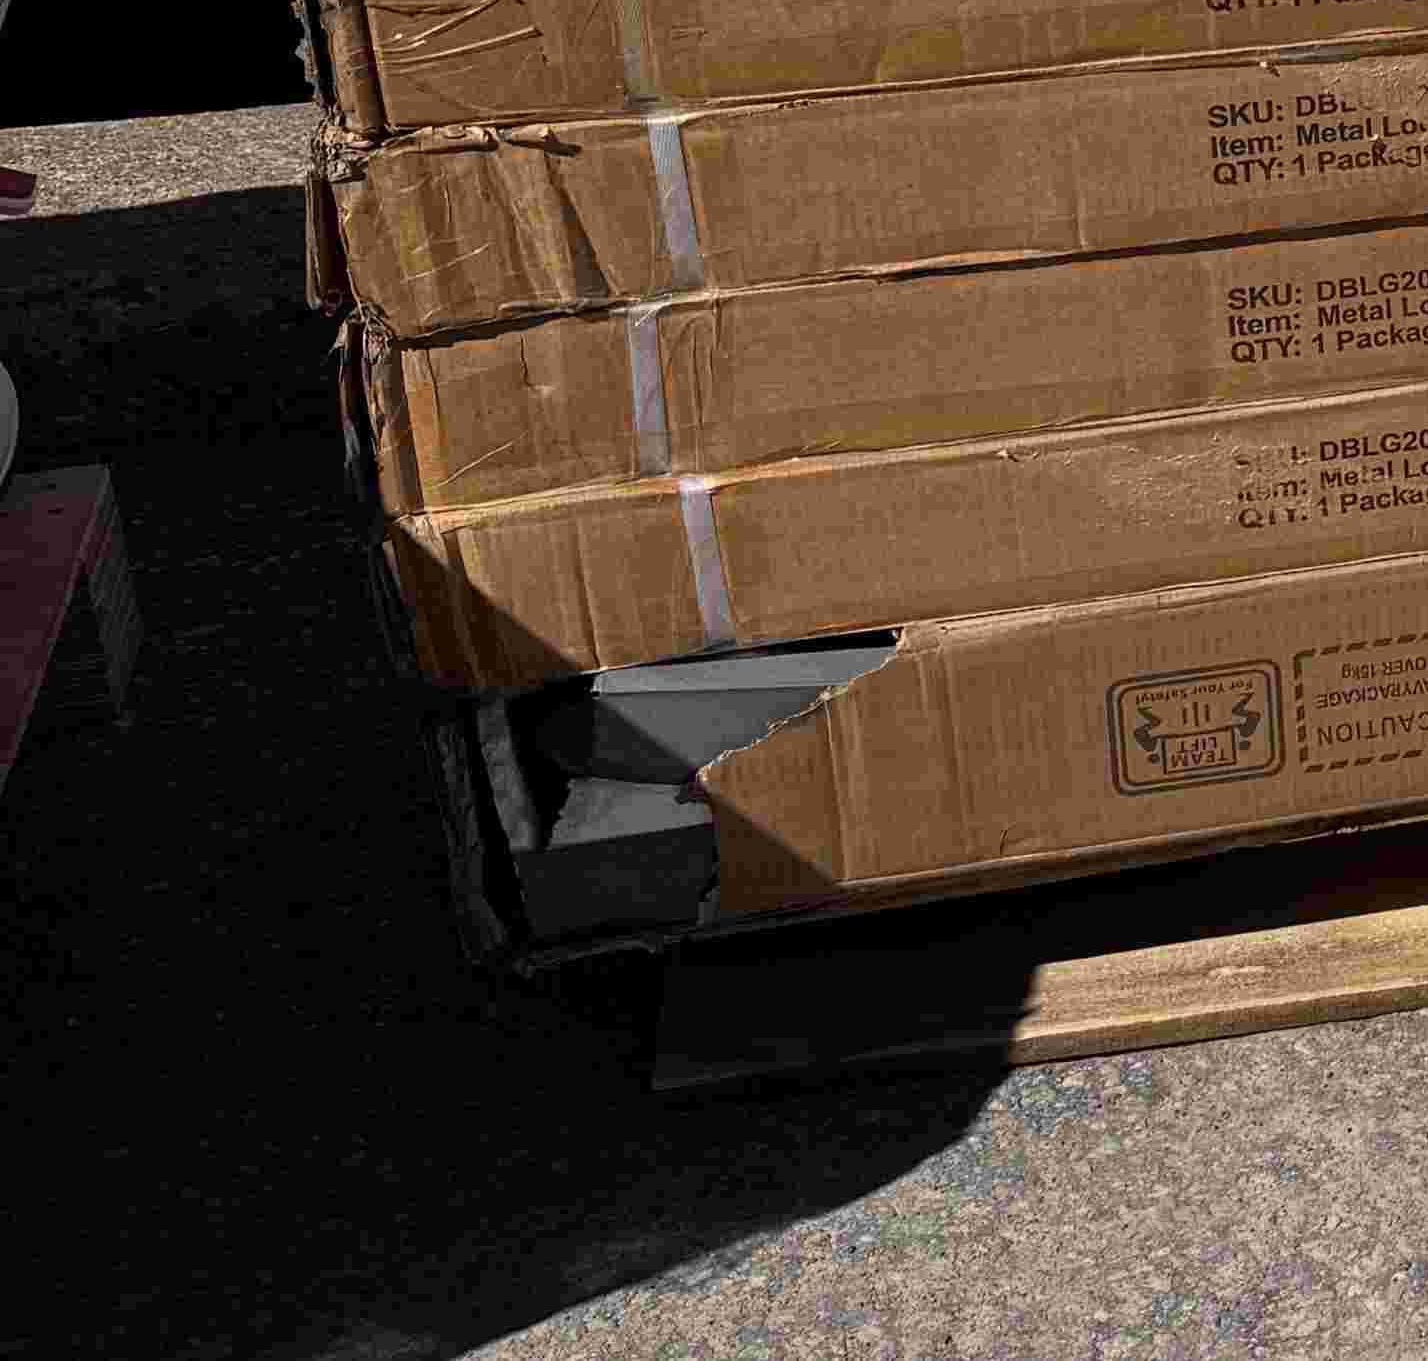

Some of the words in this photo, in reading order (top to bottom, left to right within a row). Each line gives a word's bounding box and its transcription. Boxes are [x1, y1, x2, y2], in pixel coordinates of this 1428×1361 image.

[1207, 100, 1284, 128] SKU:
[1210, 132, 1284, 159] Item:
[1296, 116, 1372, 147] Metal
[1213, 156, 1284, 185] QTY:
[1293, 156, 1306, 178] 1
[1227, 284, 1302, 311] SKU:
[1229, 312, 1302, 338] Item:
[1318, 297, 1393, 328] Metal
[1230, 337, 1302, 364] QTY:
[1311, 332, 1325, 355] 1
[1319, 460, 1394, 489] Metal
[1341, 661, 1375, 679] 15kg
[1383, 656, 1427, 676] OVER
[1193, 682, 1225, 695] Your
[1231, 678, 1253, 689] For
[1180, 735, 1218, 752] LIFT
[1170, 748, 1225, 769] TEAM
